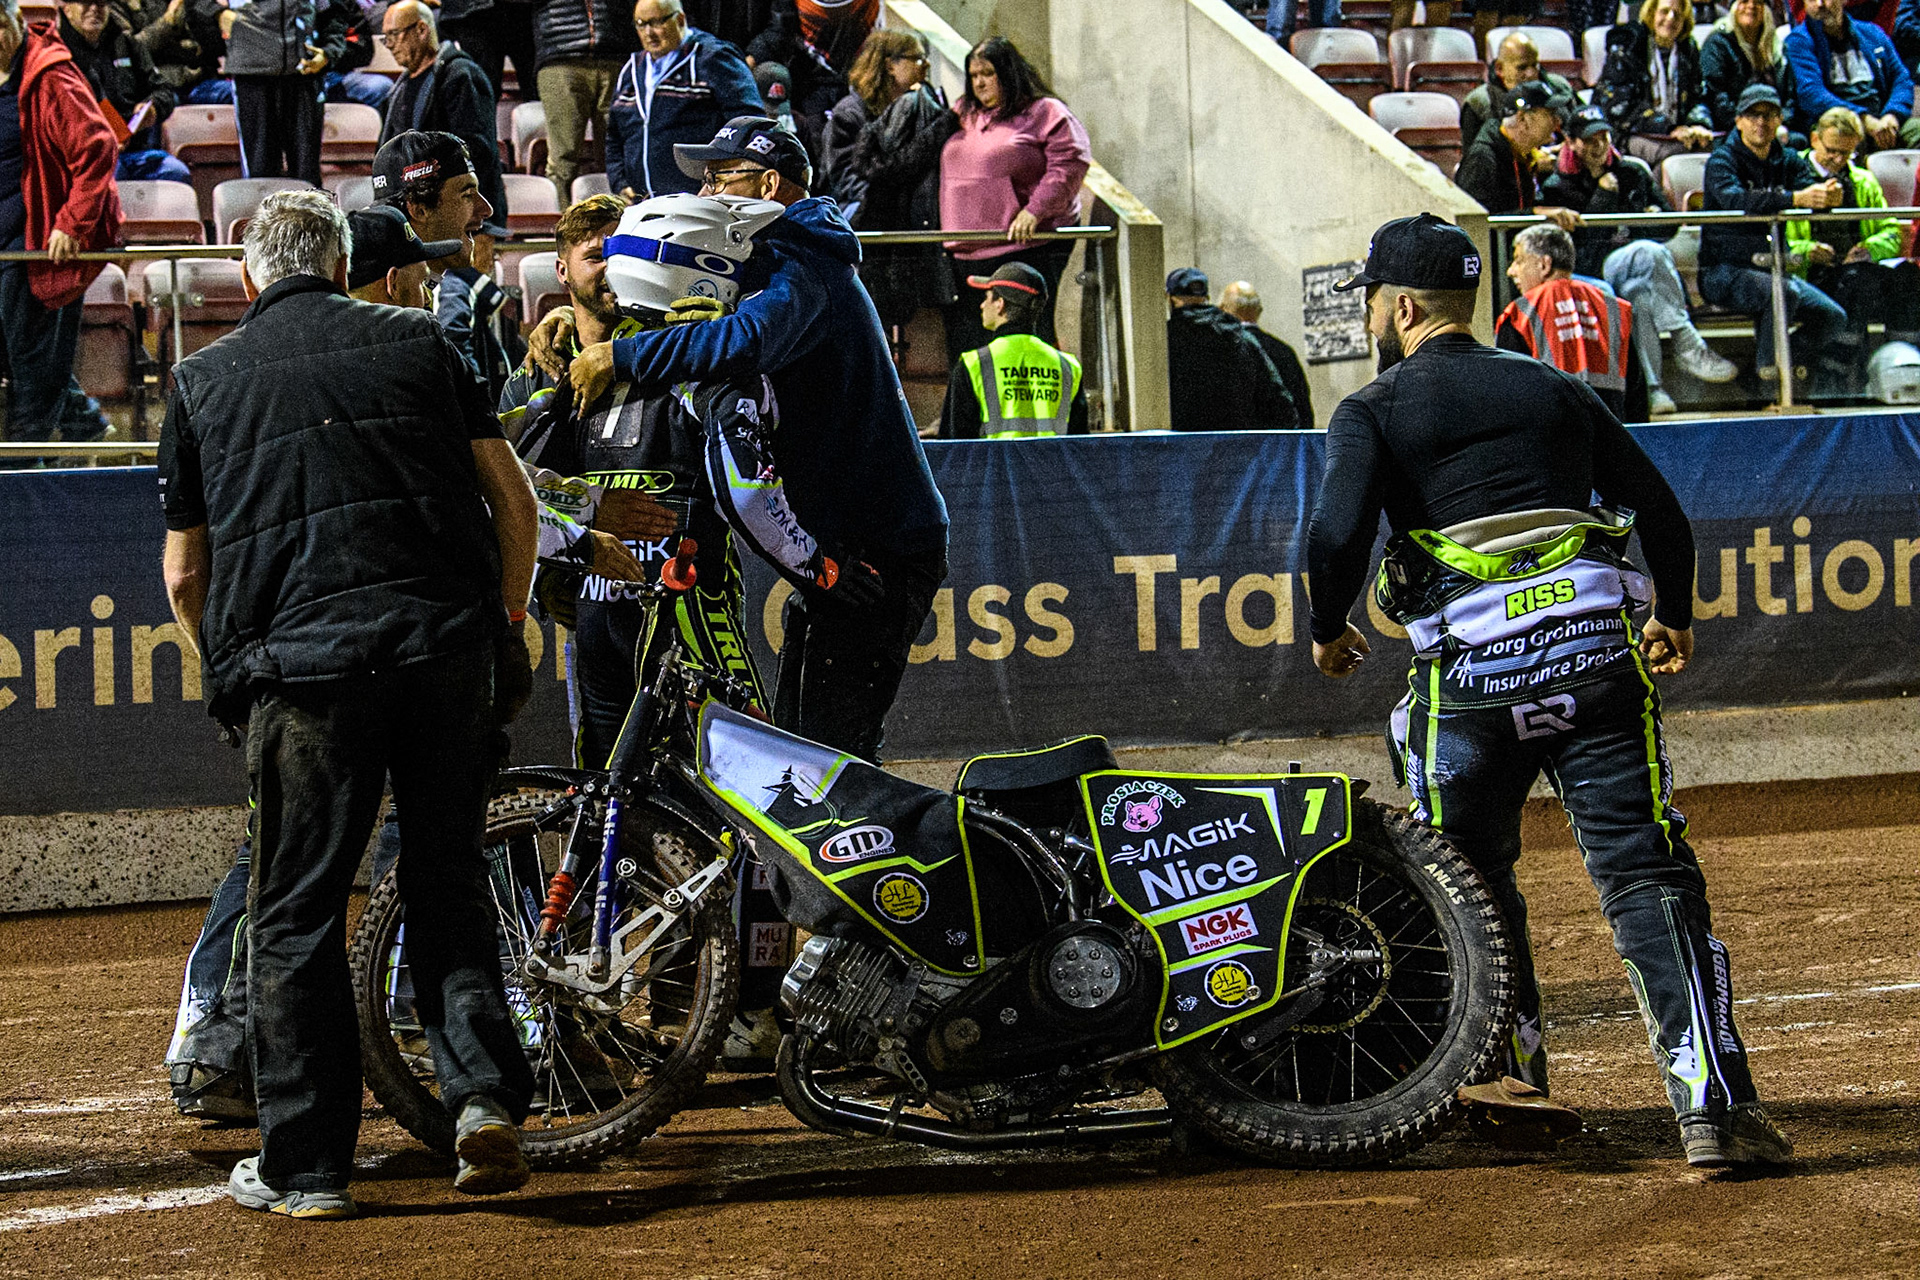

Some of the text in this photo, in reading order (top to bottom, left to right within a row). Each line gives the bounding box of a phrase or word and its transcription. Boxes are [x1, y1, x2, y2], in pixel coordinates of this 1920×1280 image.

[745, 135, 776, 155] 89
[1000, 367, 1060, 380] TAURUS
[1004, 388, 1059, 402] STEWARD
[1505, 577, 1576, 620] RISS
[1529, 616, 1623, 646] Grohmann
[1482, 658, 1572, 694] Insurance
[1101, 781, 1187, 826] PROSIACZEK
[1300, 787, 1328, 836] 1
[829, 831, 884, 858] GM
[858, 846, 896, 860] ENGINES
[1138, 853, 1259, 908] Nice
[1423, 862, 1466, 905] ANLAS
[1185, 907, 1249, 943] NGK
[1193, 928, 1253, 952] SPARK PLUGS
